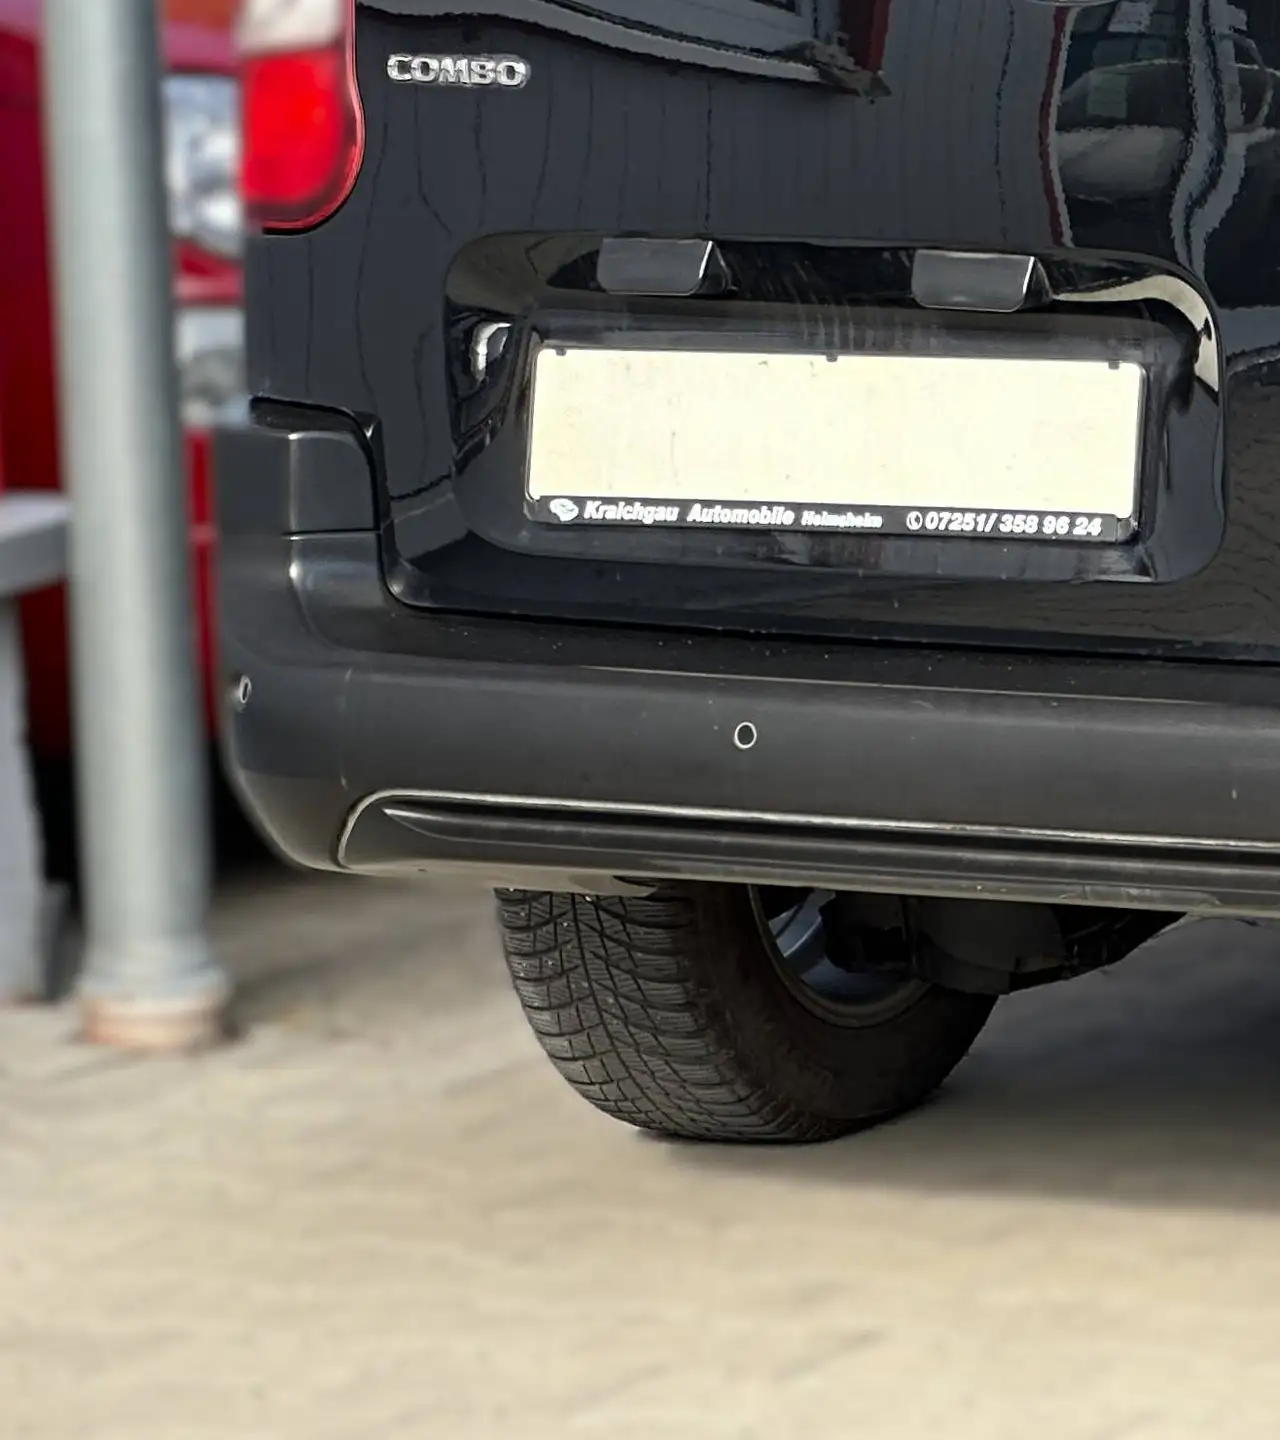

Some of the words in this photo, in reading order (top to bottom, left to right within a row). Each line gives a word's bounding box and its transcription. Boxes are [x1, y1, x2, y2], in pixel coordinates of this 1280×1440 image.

[386, 54, 527, 86] COMBO
[584, 500, 680, 525] Kraichgau
[687, 503, 795, 525] Automobile
[1000, 513, 1039, 534] 358
[1042, 515, 1071, 535] 96
[1073, 517, 1102, 536] 24
